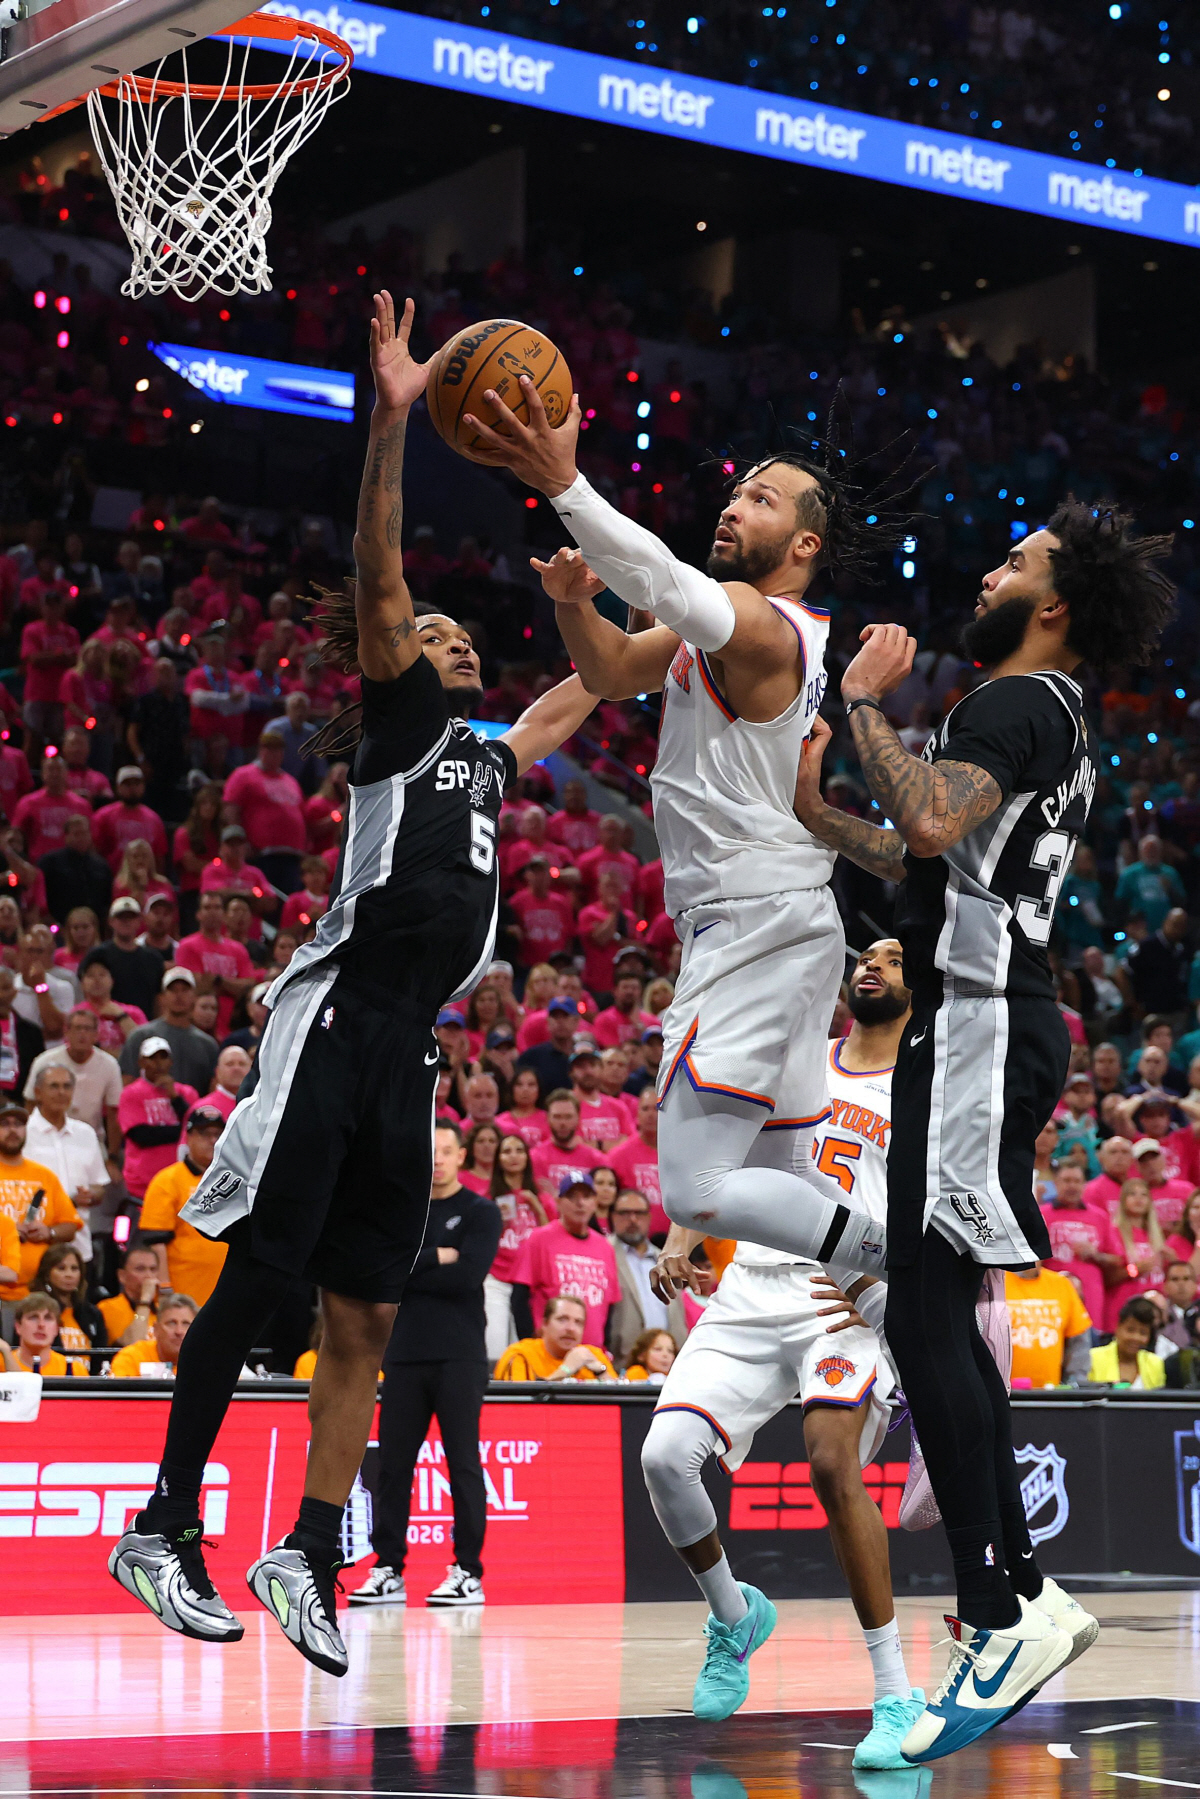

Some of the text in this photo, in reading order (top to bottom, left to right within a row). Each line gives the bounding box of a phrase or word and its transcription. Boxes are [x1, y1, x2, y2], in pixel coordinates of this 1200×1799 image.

[433, 37, 555, 95] meter
[598, 73, 715, 130] meter
[755, 107, 867, 162] meter
[905, 139, 1012, 194] meter
[1048, 170, 1149, 224] meter
[469, 809, 495, 876] 5
[828, 1098, 892, 1150] YORK
[811, 1136, 863, 1195] 5
[814, 1357, 857, 1376] KNICKS
[495, 1440, 540, 1464] CUP
[411, 1467, 529, 1512] INAL
[406, 1524, 445, 1545] 026
